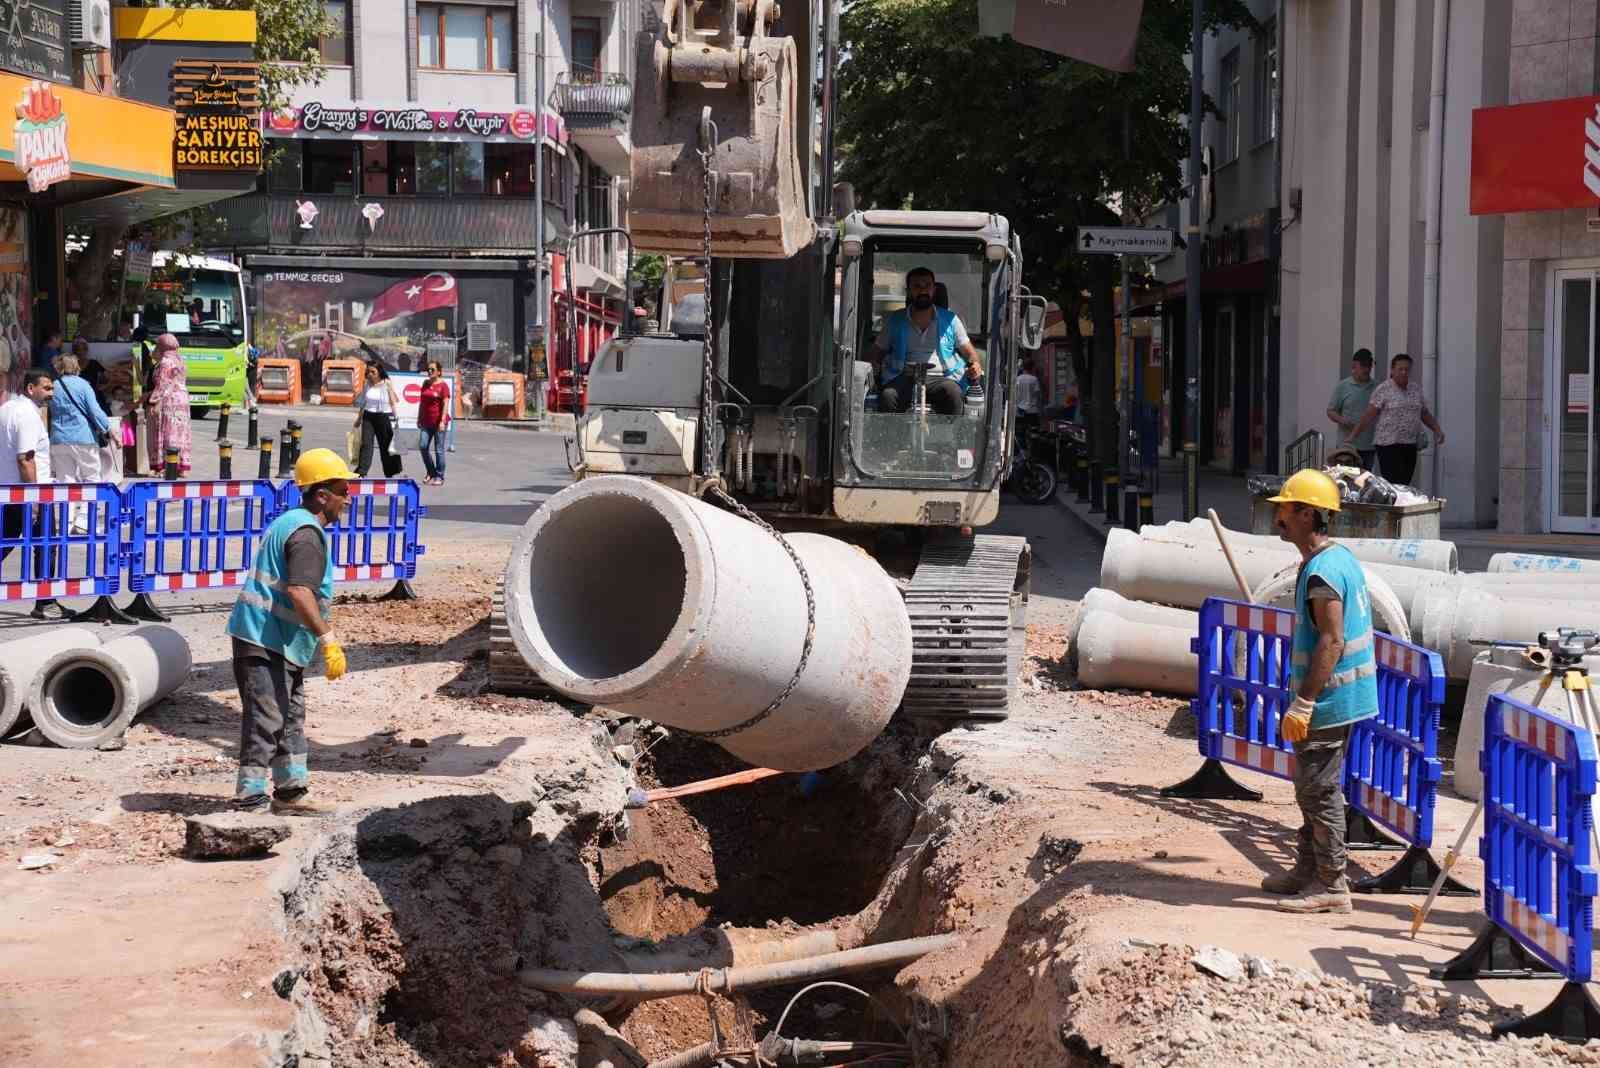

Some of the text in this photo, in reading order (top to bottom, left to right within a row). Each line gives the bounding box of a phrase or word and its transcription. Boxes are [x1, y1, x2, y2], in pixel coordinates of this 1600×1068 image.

[186, 116, 248, 132] MEŞHUR
[303, 103, 367, 131] Granny's
[438, 117, 448, 128] &
[454, 109, 505, 135] Kumpir
[20, 121, 69, 172] PARK
[177, 131, 260, 148] SARIYER
[177, 148, 260, 167] BÖREKÇİSİ
[274, 272, 309, 282] TEMMUZ
